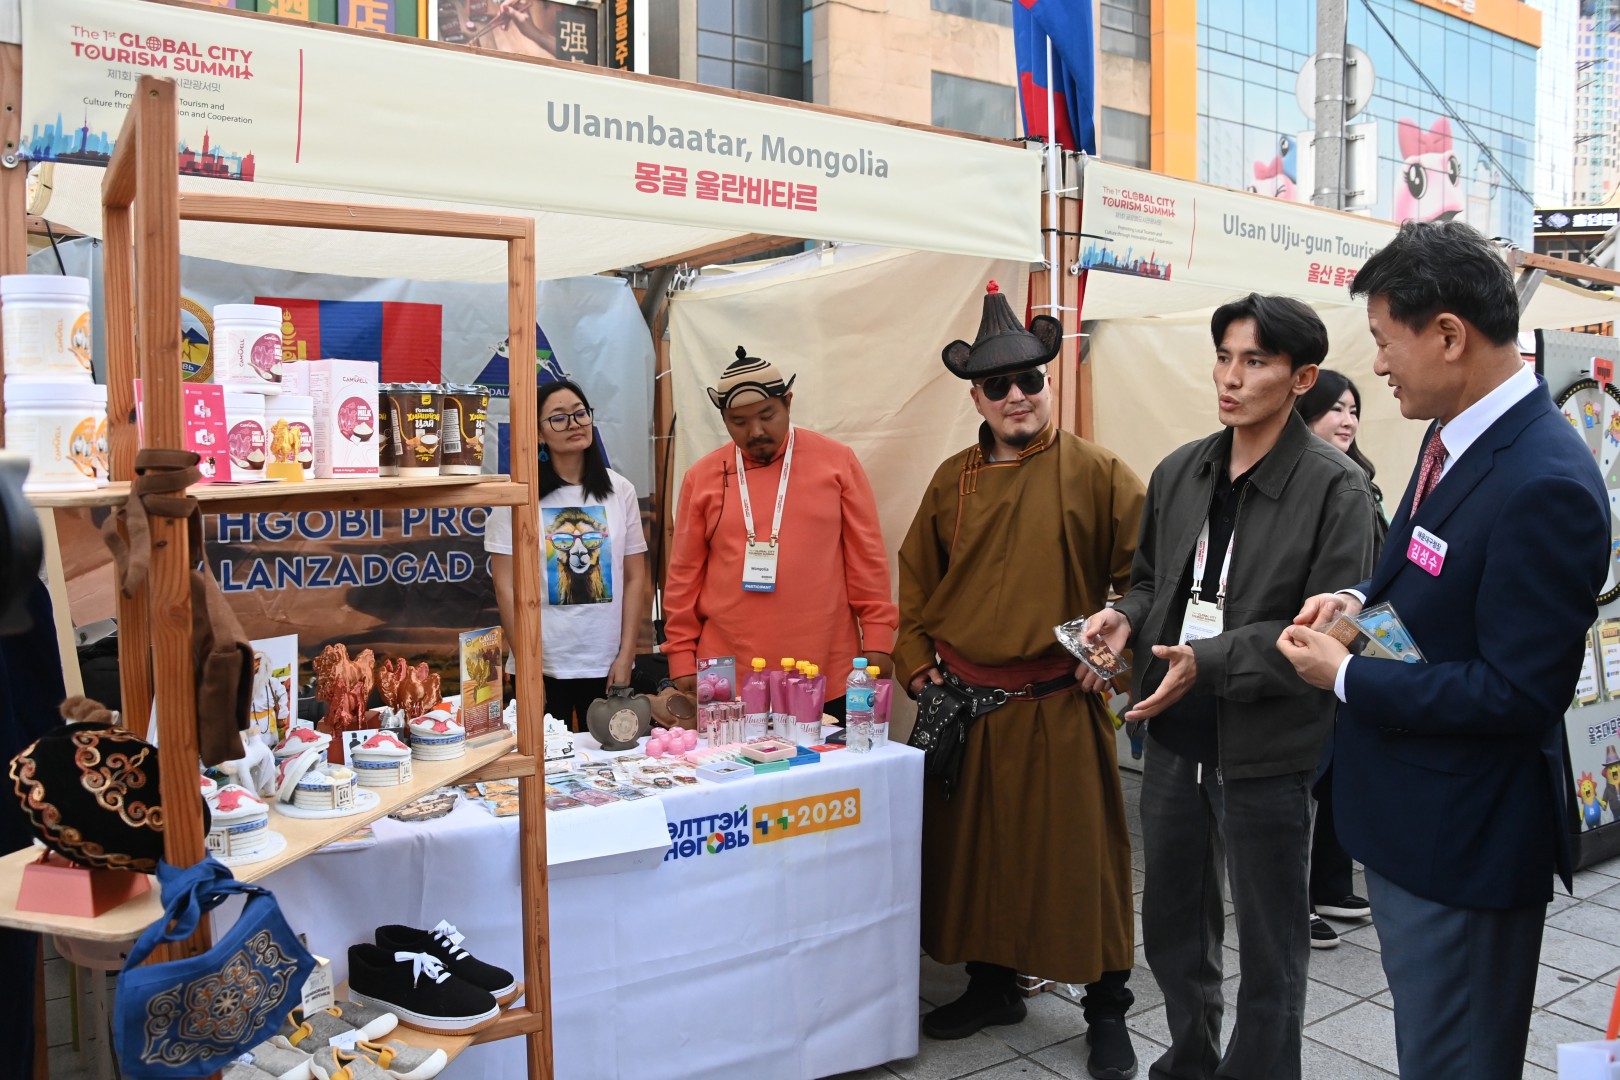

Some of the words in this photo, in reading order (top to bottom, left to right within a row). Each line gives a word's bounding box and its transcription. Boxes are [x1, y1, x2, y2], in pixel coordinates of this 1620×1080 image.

[70, 41, 168, 69] TOURISM
[71, 25, 99, 40] The
[103, 30, 116, 42] 1st
[207, 45, 253, 64] CITY
[559, 20, 589, 64] 强
[107, 68, 132, 82] 제1회
[83, 97, 112, 108] Culture
[191, 110, 206, 119] and
[207, 112, 253, 124] Cooperation
[179, 98, 208, 110] Tourism
[210, 103, 225, 111] and
[546, 101, 753, 163] Ulannbaatar,
[761, 134, 889, 179] Mongolia
[634, 161, 688, 197] 몽골
[695, 169, 818, 212] 울란바타르
[1102, 196, 1142, 212] TOURISM
[1156, 197, 1175, 208] CITY
[1223, 213, 1266, 241] Ulsan
[1270, 223, 1332, 255] Ulju-gun
[1307, 262, 1333, 285] 울산
[489, 388, 510, 397] DAL
[1411, 543, 1437, 570] 김성수
[797, 796, 857, 828] 2028
